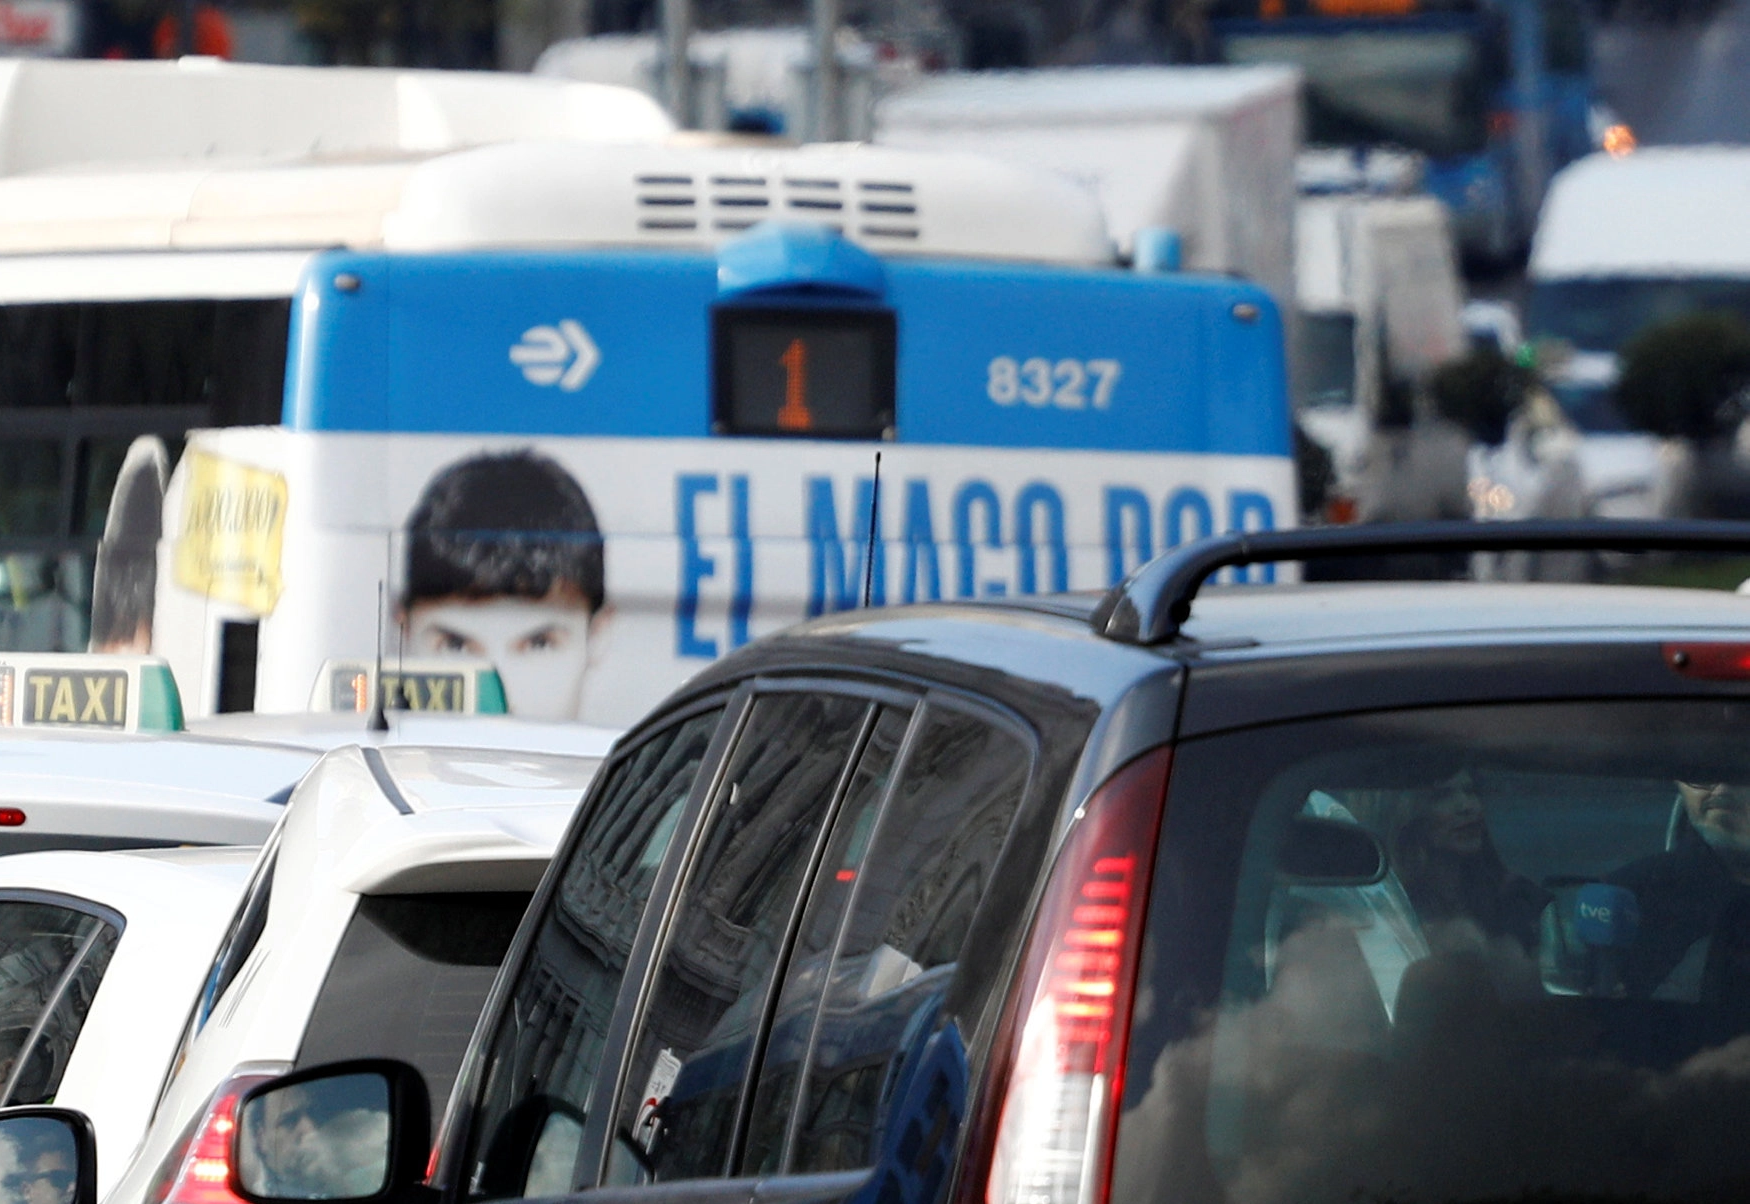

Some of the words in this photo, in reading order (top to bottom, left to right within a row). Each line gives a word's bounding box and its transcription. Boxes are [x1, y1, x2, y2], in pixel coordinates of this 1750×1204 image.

[777, 338, 812, 431] 1
[986, 355, 1122, 409] 8327
[29, 675, 125, 722] TAXI
[381, 676, 463, 711] TAXI
[1580, 902, 1611, 922] tve
